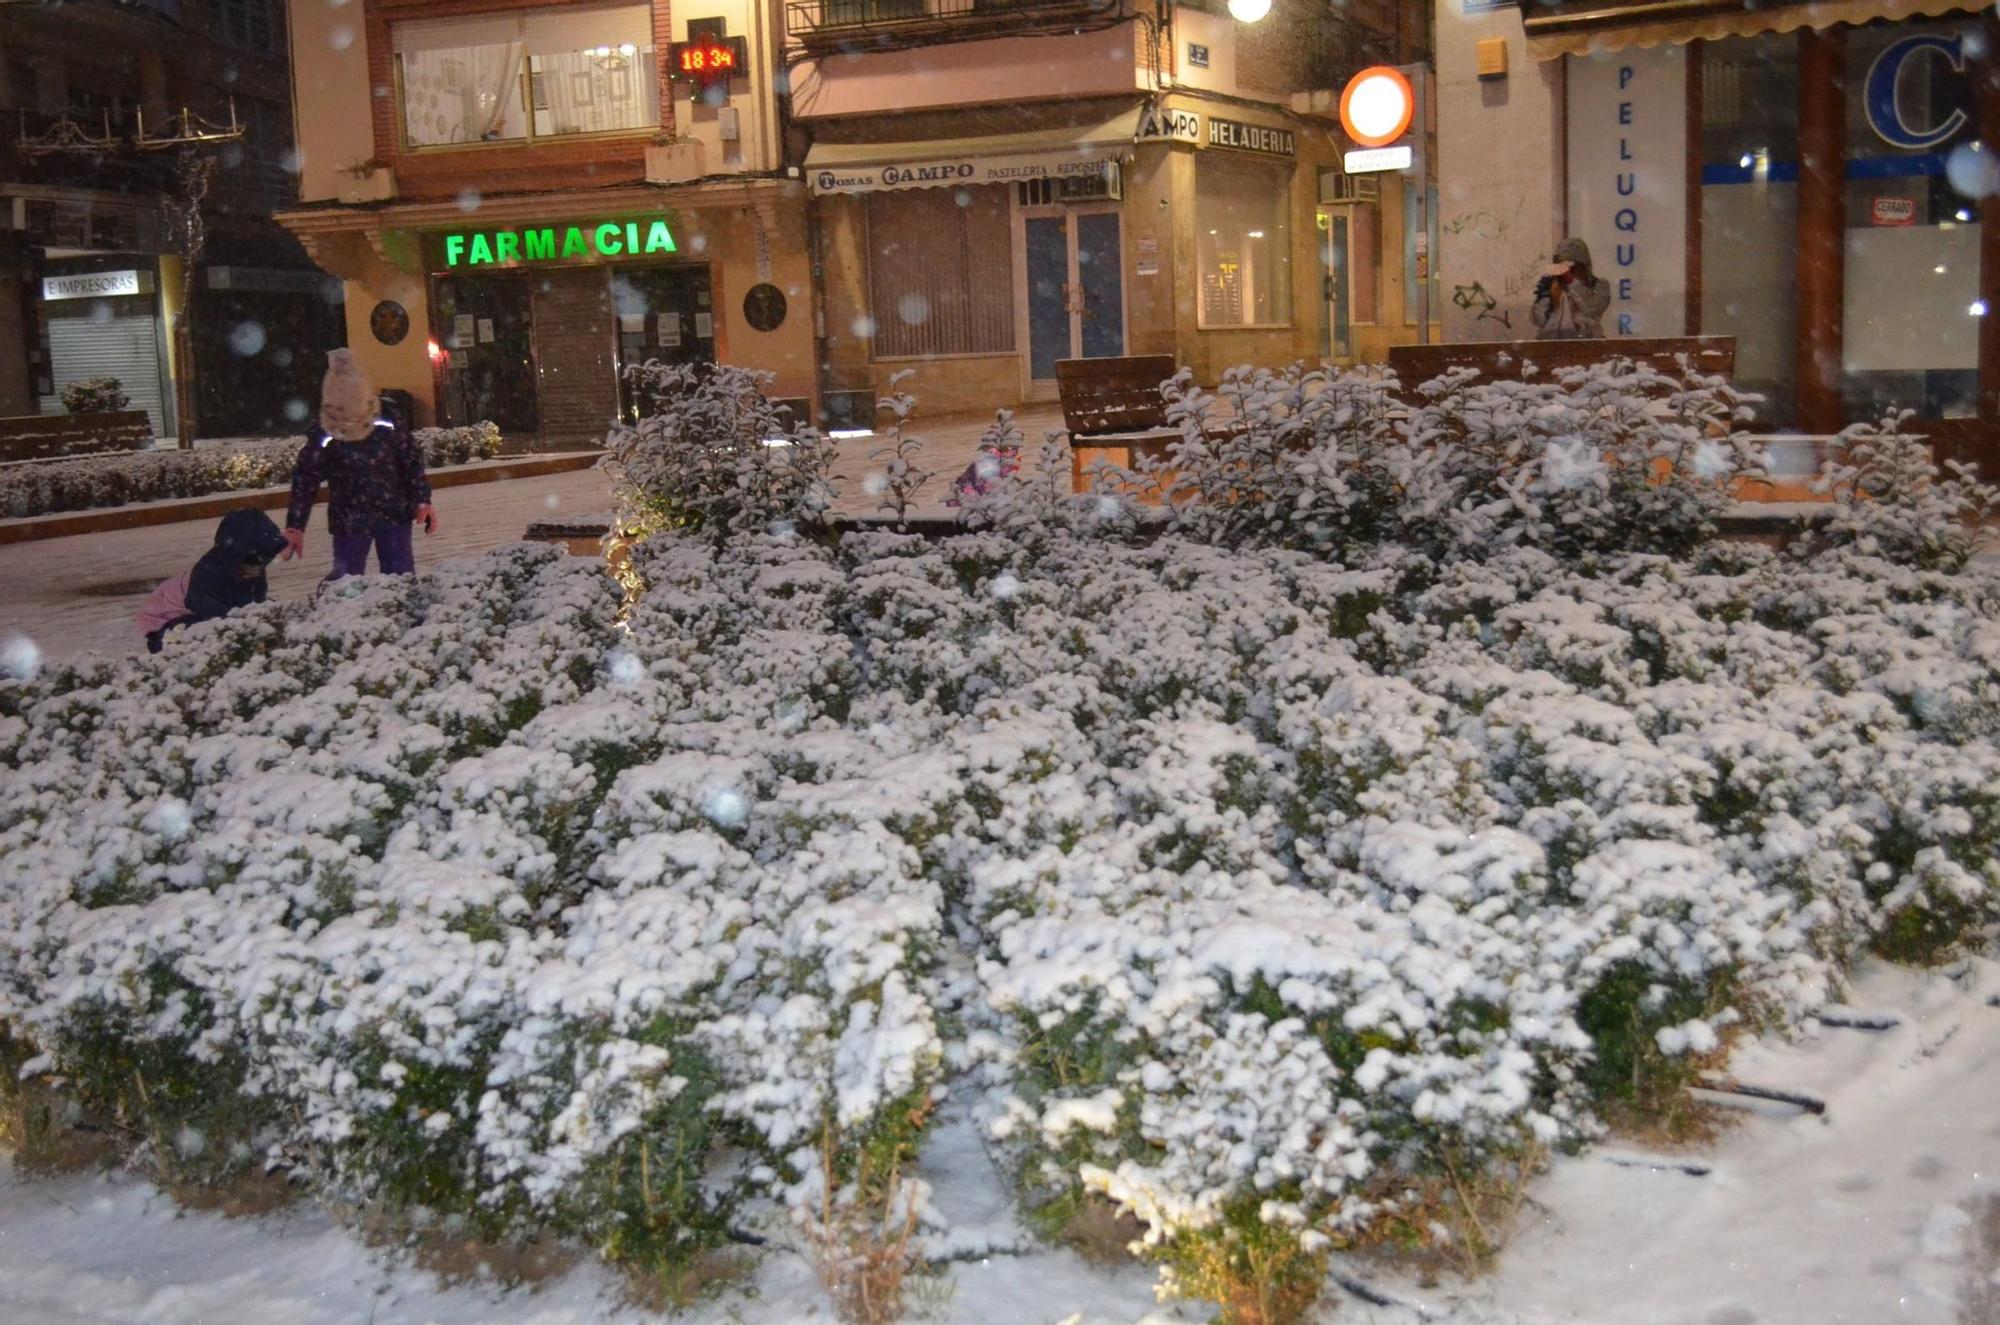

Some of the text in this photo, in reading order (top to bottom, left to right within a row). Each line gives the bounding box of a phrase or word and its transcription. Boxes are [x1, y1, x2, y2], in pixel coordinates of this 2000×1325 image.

[682, 49, 732, 70] 18 34
[1863, 34, 1967, 149] C
[1209, 120, 1294, 154] HELADERIA
[882, 163, 975, 186] CAMPO
[1615, 66, 1637, 335] PELUQUER
[446, 221, 677, 266] FARMACIA
[48, 275, 134, 295] E IMPRESORAS
